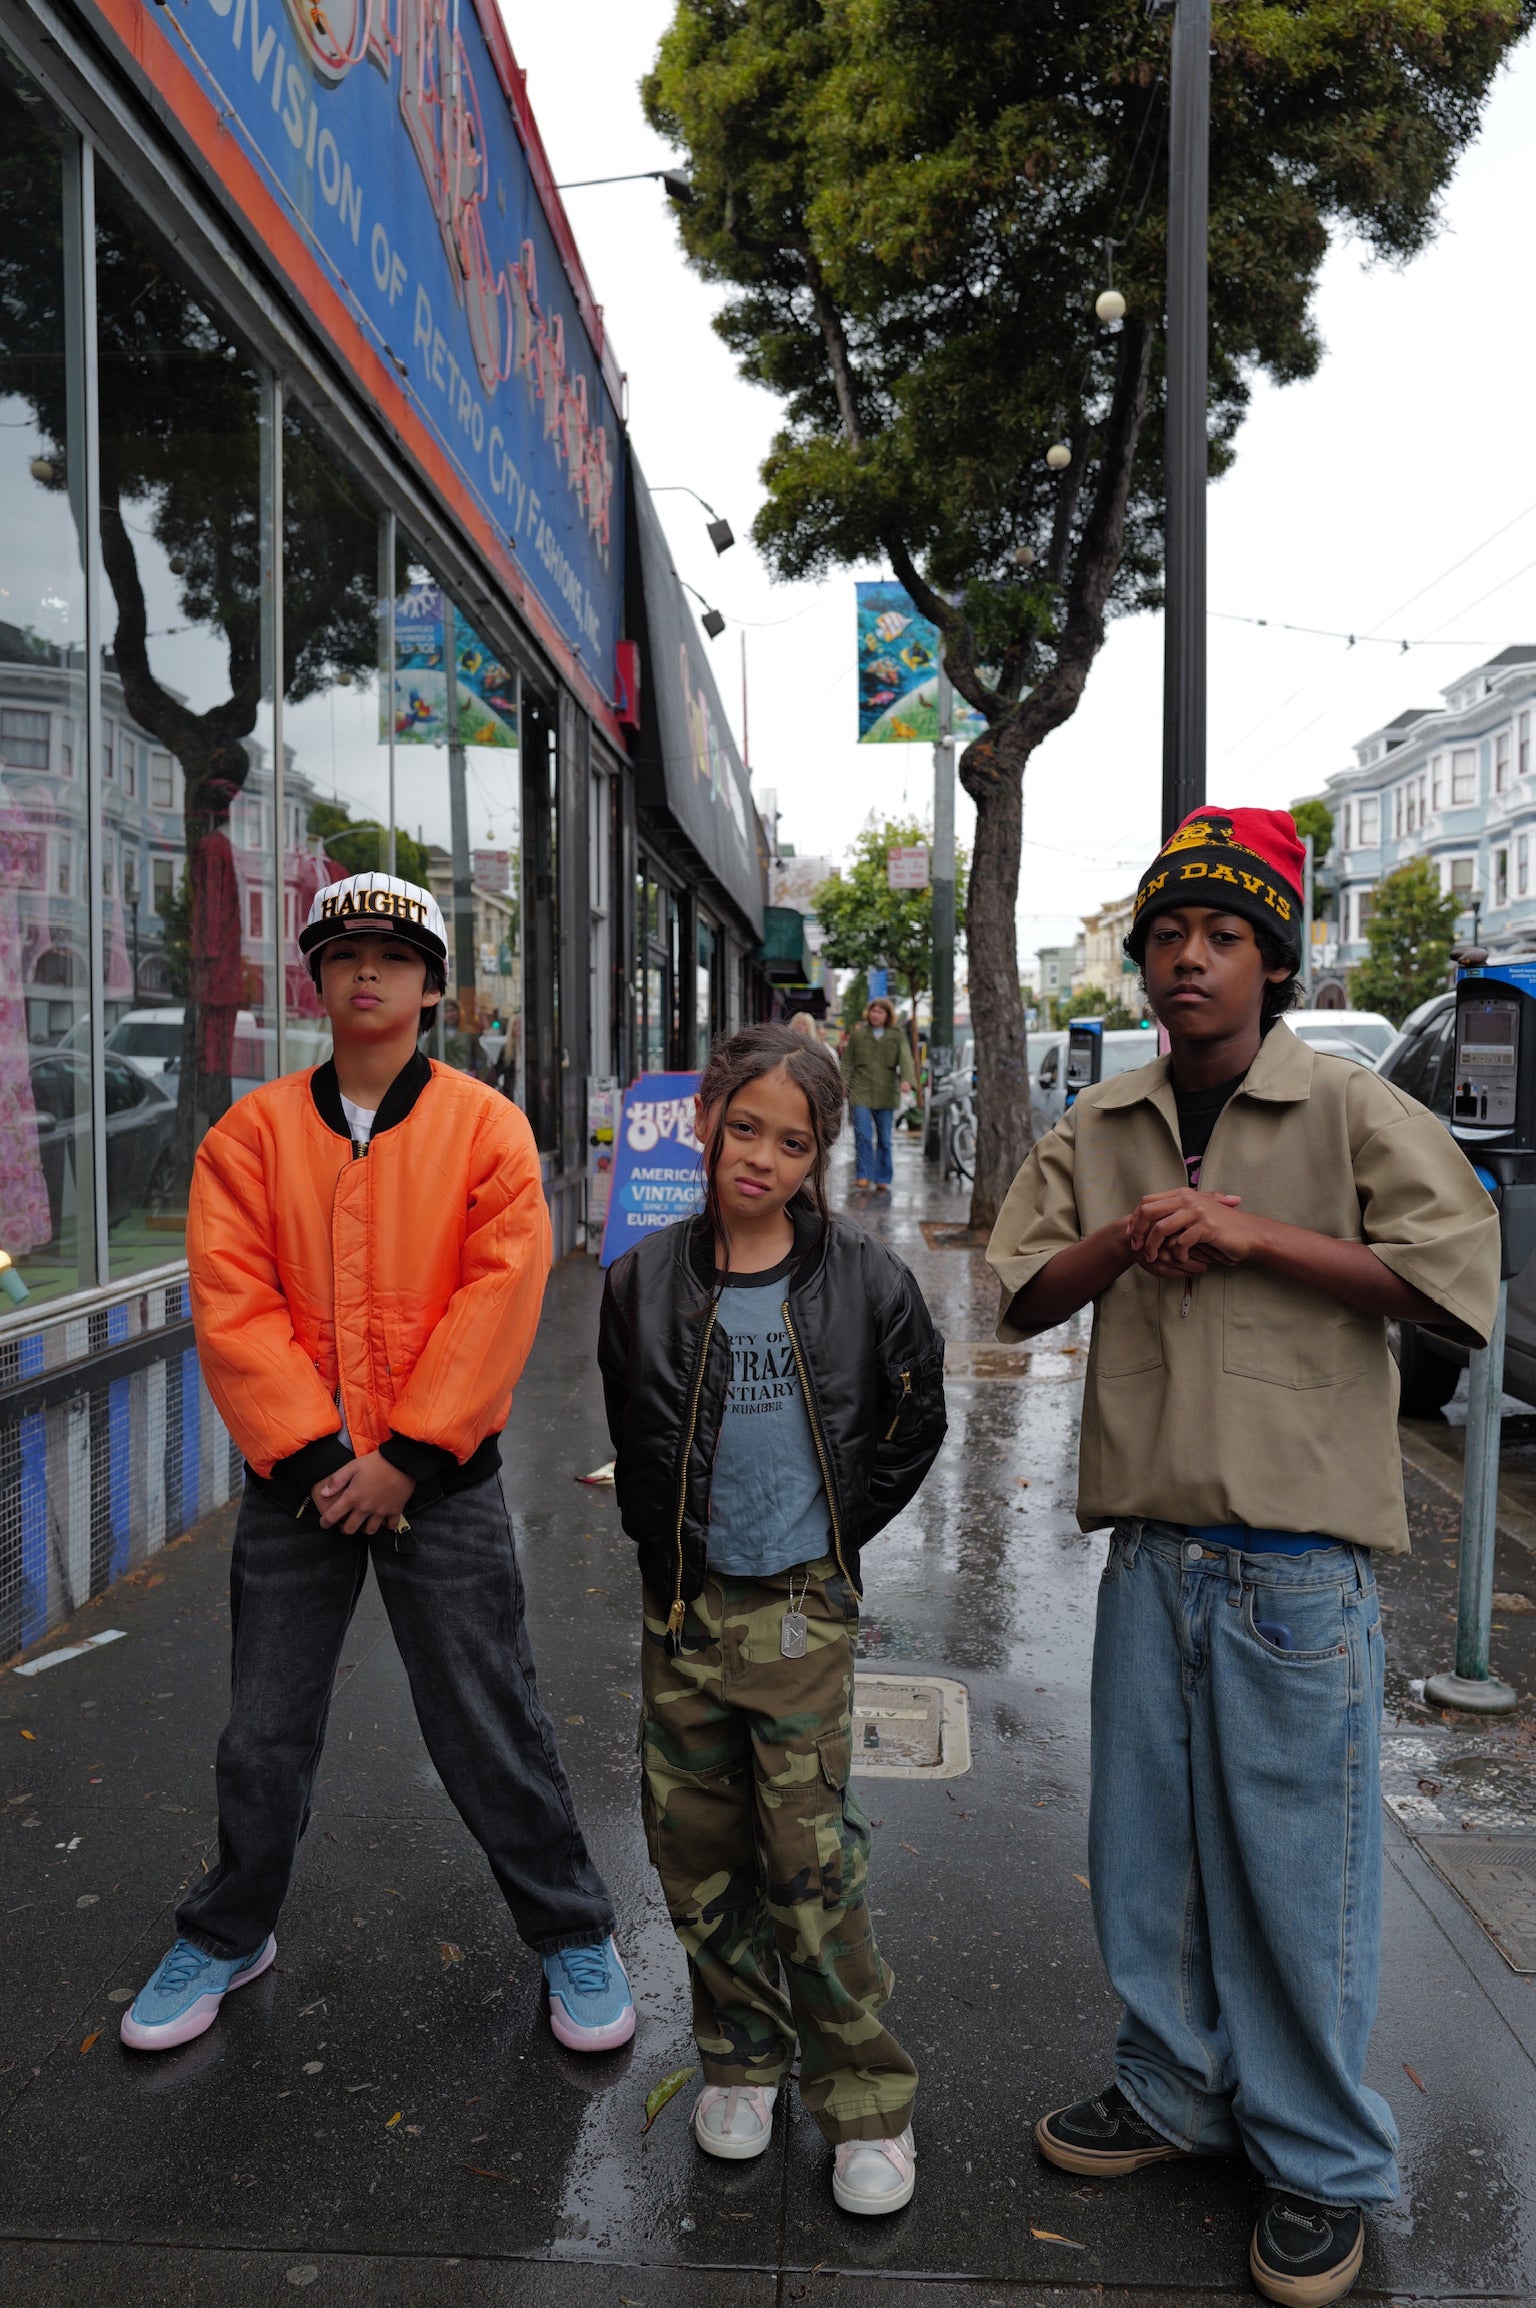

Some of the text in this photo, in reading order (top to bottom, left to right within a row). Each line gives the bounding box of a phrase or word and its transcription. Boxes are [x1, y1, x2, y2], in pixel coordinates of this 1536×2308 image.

[207, 0, 363, 245] IVISION
[371, 223, 407, 307] OF
[413, 283, 485, 452] RETRO
[488, 425, 526, 533] CITY
[321, 890, 427, 925] HAIGHT
[1180, 862, 1291, 922] DAVIS
[766, 1331, 788, 1343] OF
[731, 1401, 783, 1414] NUMBER
